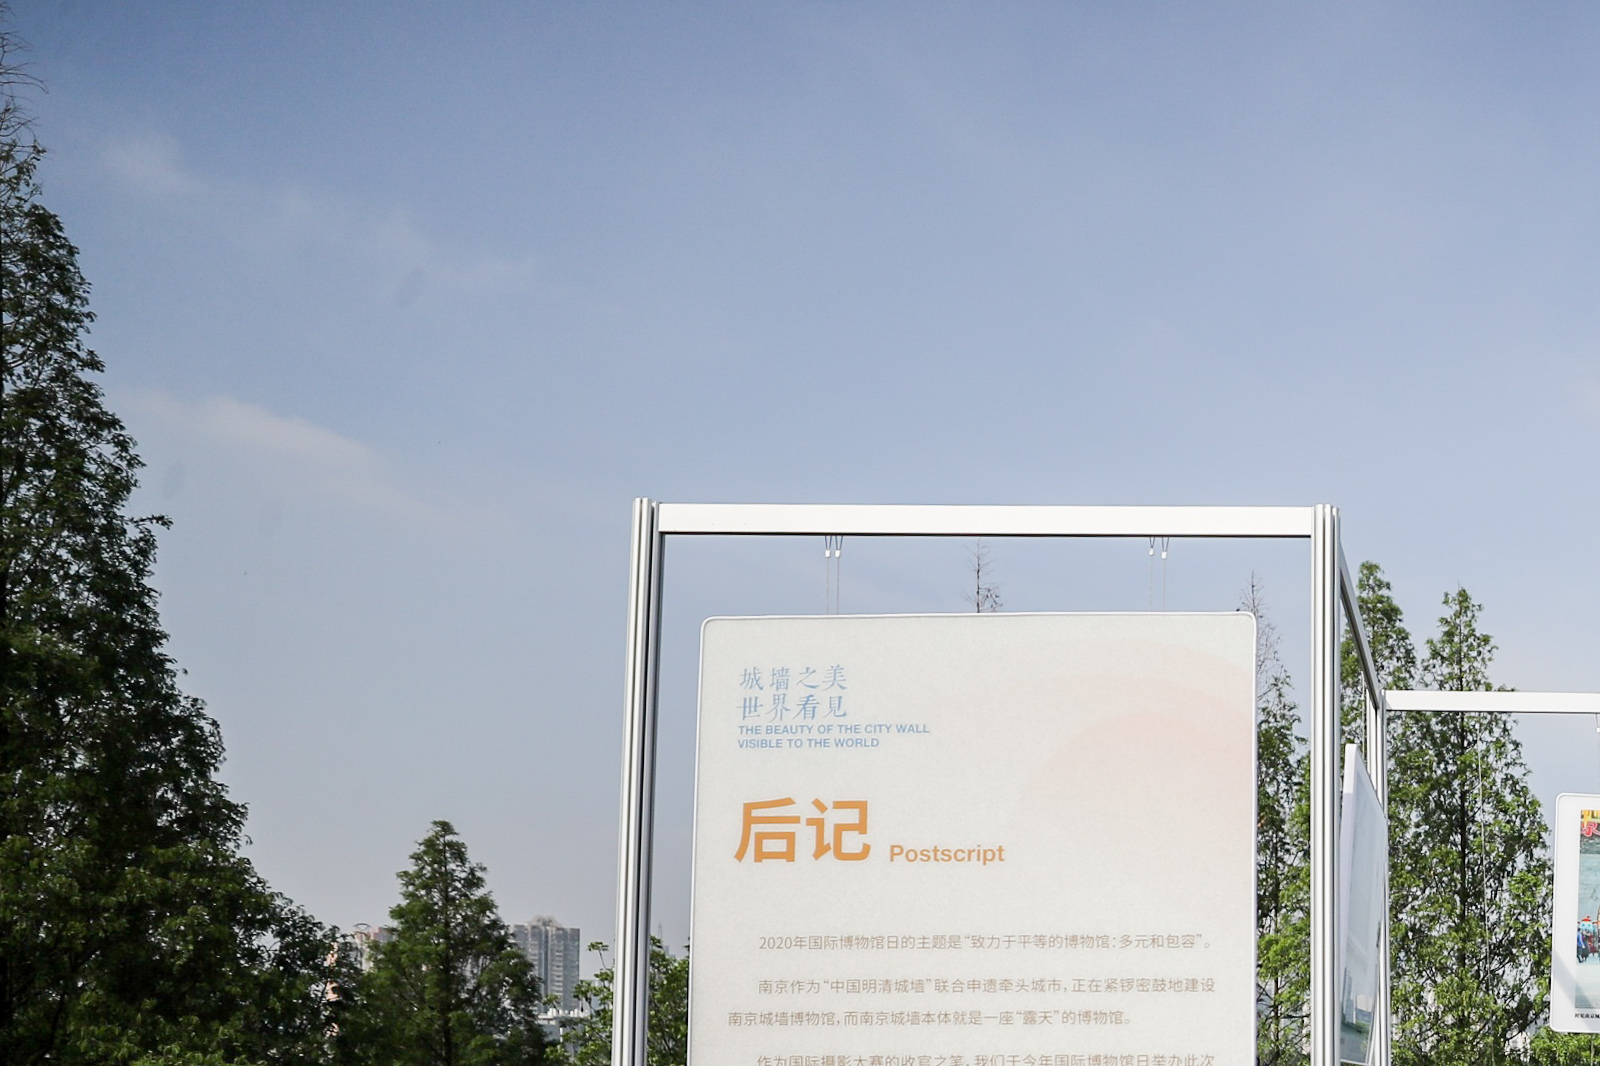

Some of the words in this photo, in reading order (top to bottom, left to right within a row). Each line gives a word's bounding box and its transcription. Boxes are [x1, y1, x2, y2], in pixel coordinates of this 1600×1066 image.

[738, 664, 848, 691] 城墙之美
[738, 725, 762, 736] THE
[765, 724, 813, 736] BEAUTY
[817, 724, 834, 735] OF
[837, 724, 861, 735] THE
[864, 724, 892, 735] CITY
[896, 723, 930, 735] WALL
[738, 738, 783, 749] VISIBLE
[787, 738, 803, 749] TO
[807, 738, 830, 749] THE
[834, 737, 880, 749] WORLD
[733, 797, 872, 863] 后记
[888, 844, 1006, 866] Postscript
